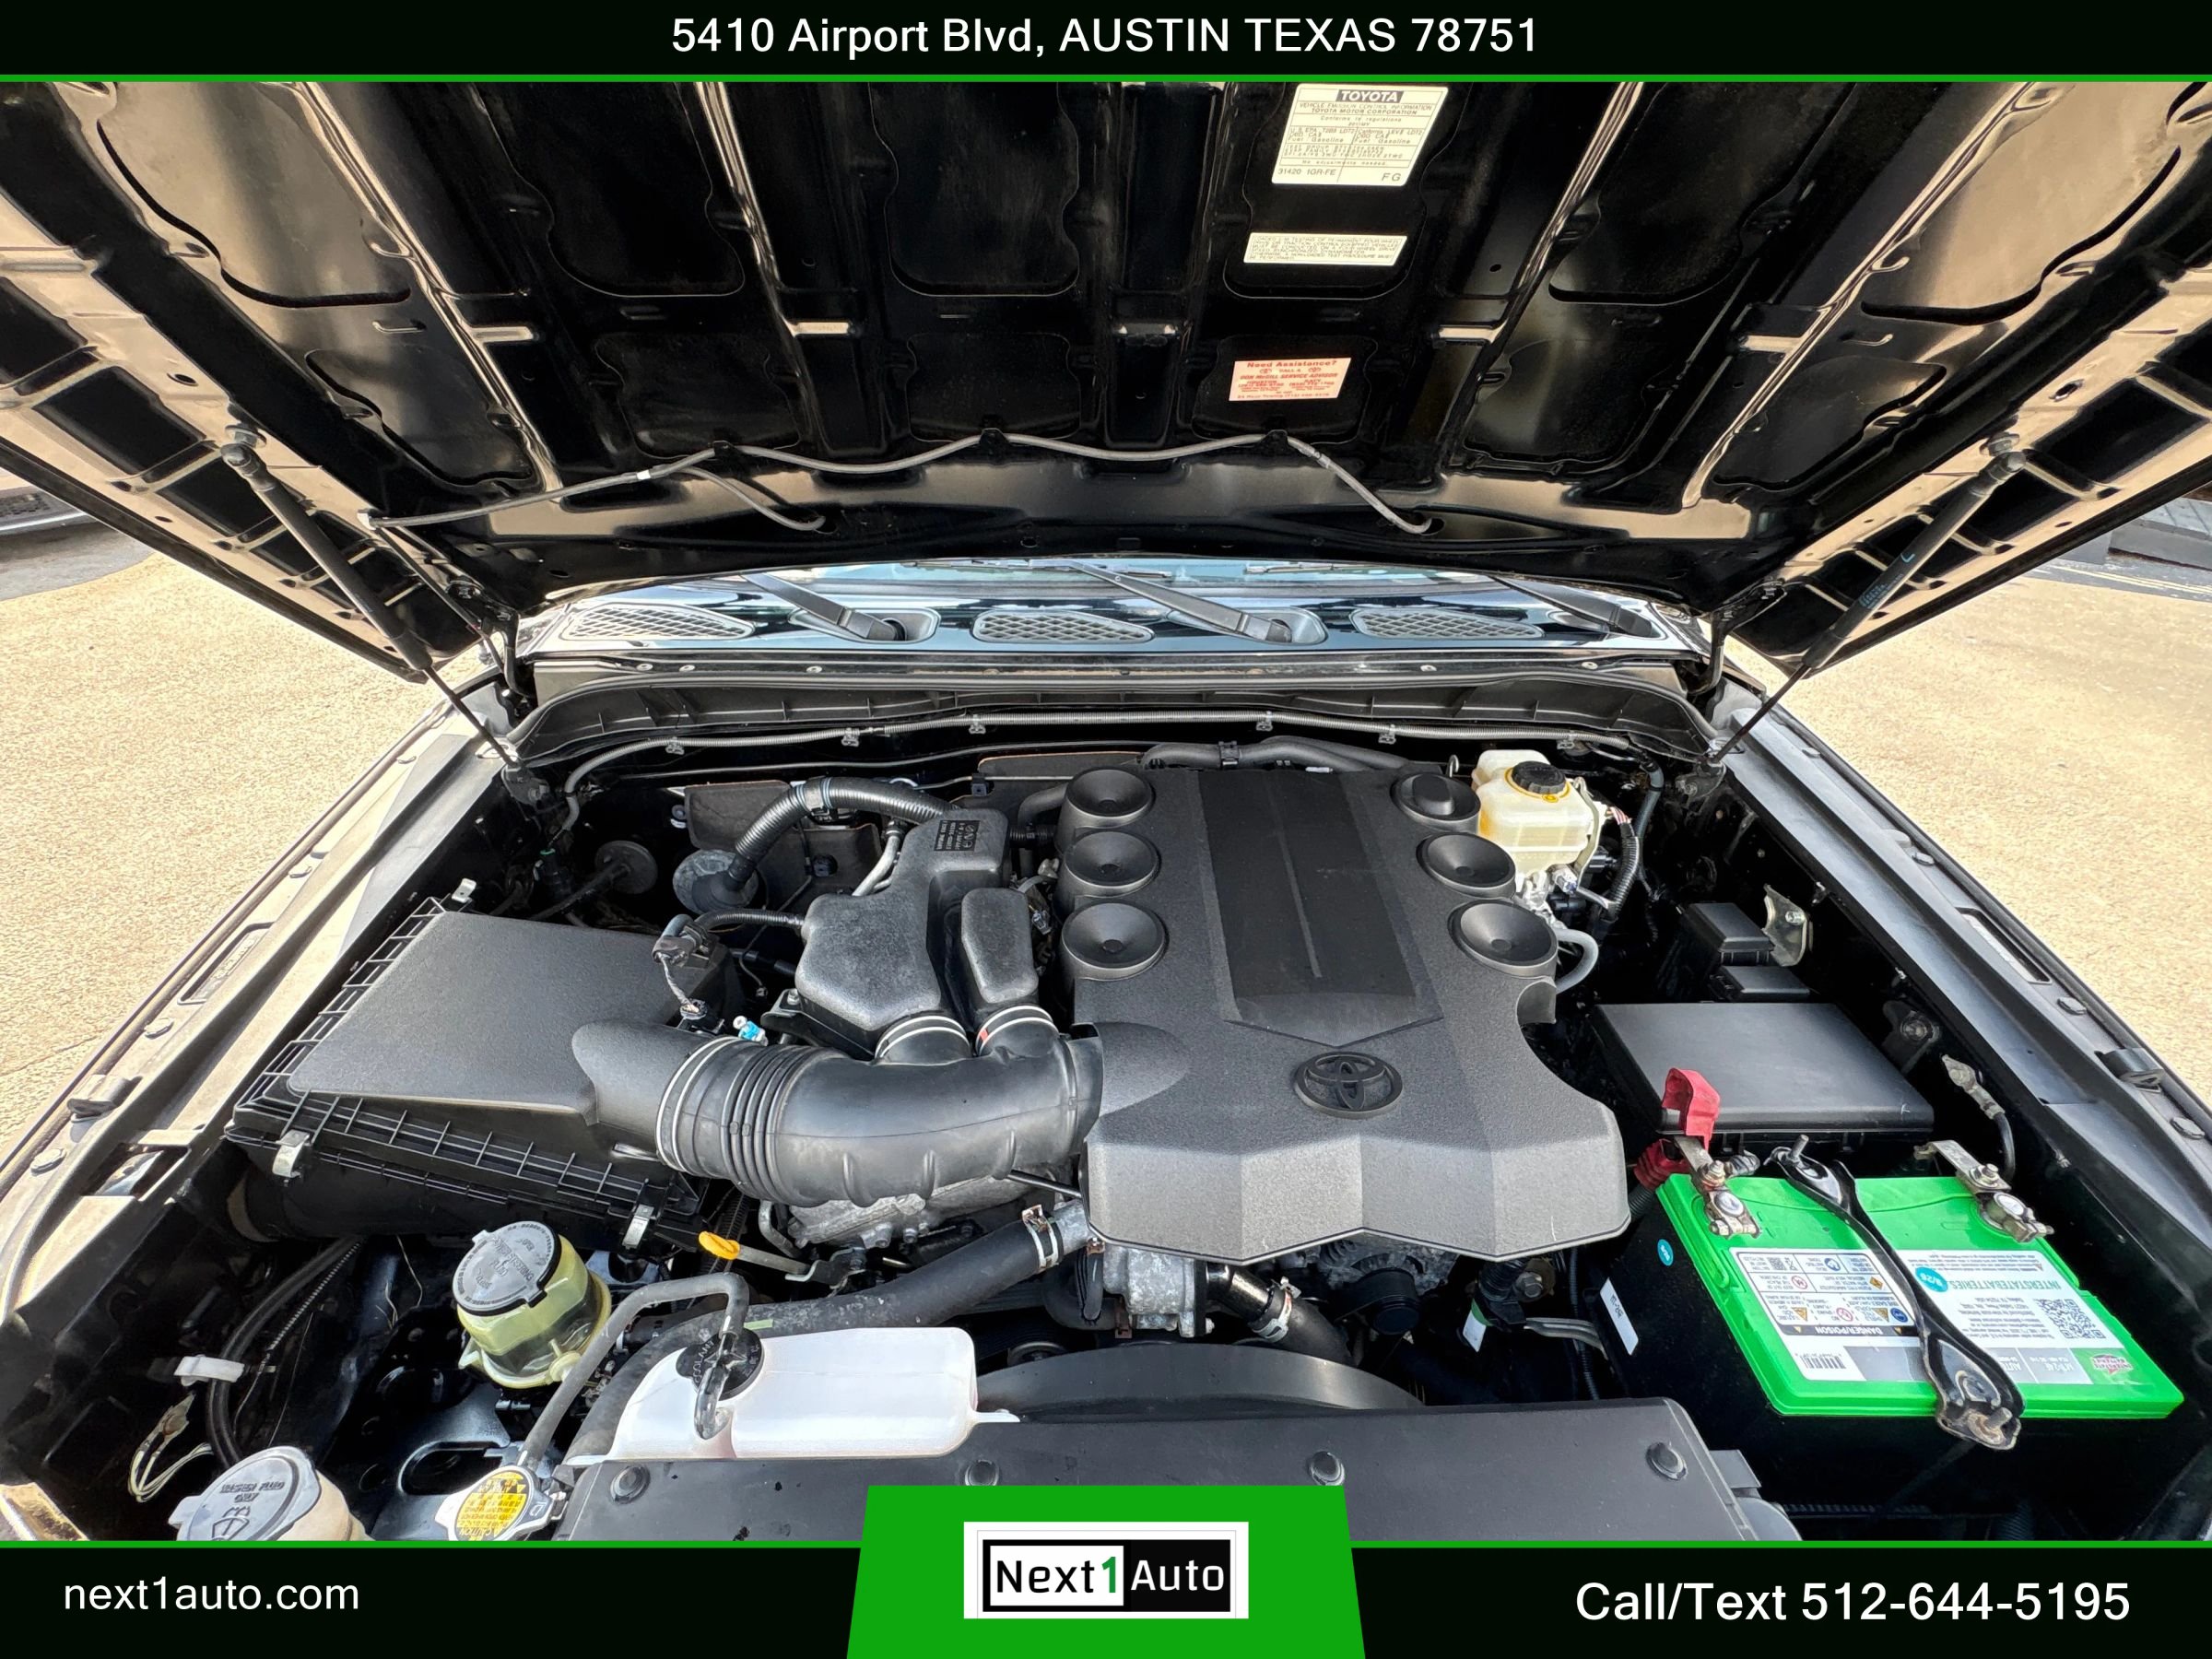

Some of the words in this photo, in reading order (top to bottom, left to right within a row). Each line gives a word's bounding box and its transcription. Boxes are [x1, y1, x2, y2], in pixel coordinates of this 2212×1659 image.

[1340, 90, 1398, 103] TOYOTA
[1815, 1326, 1883, 1335] DANGER/POISON
[692, 1340, 715, 1382] COOLANT
